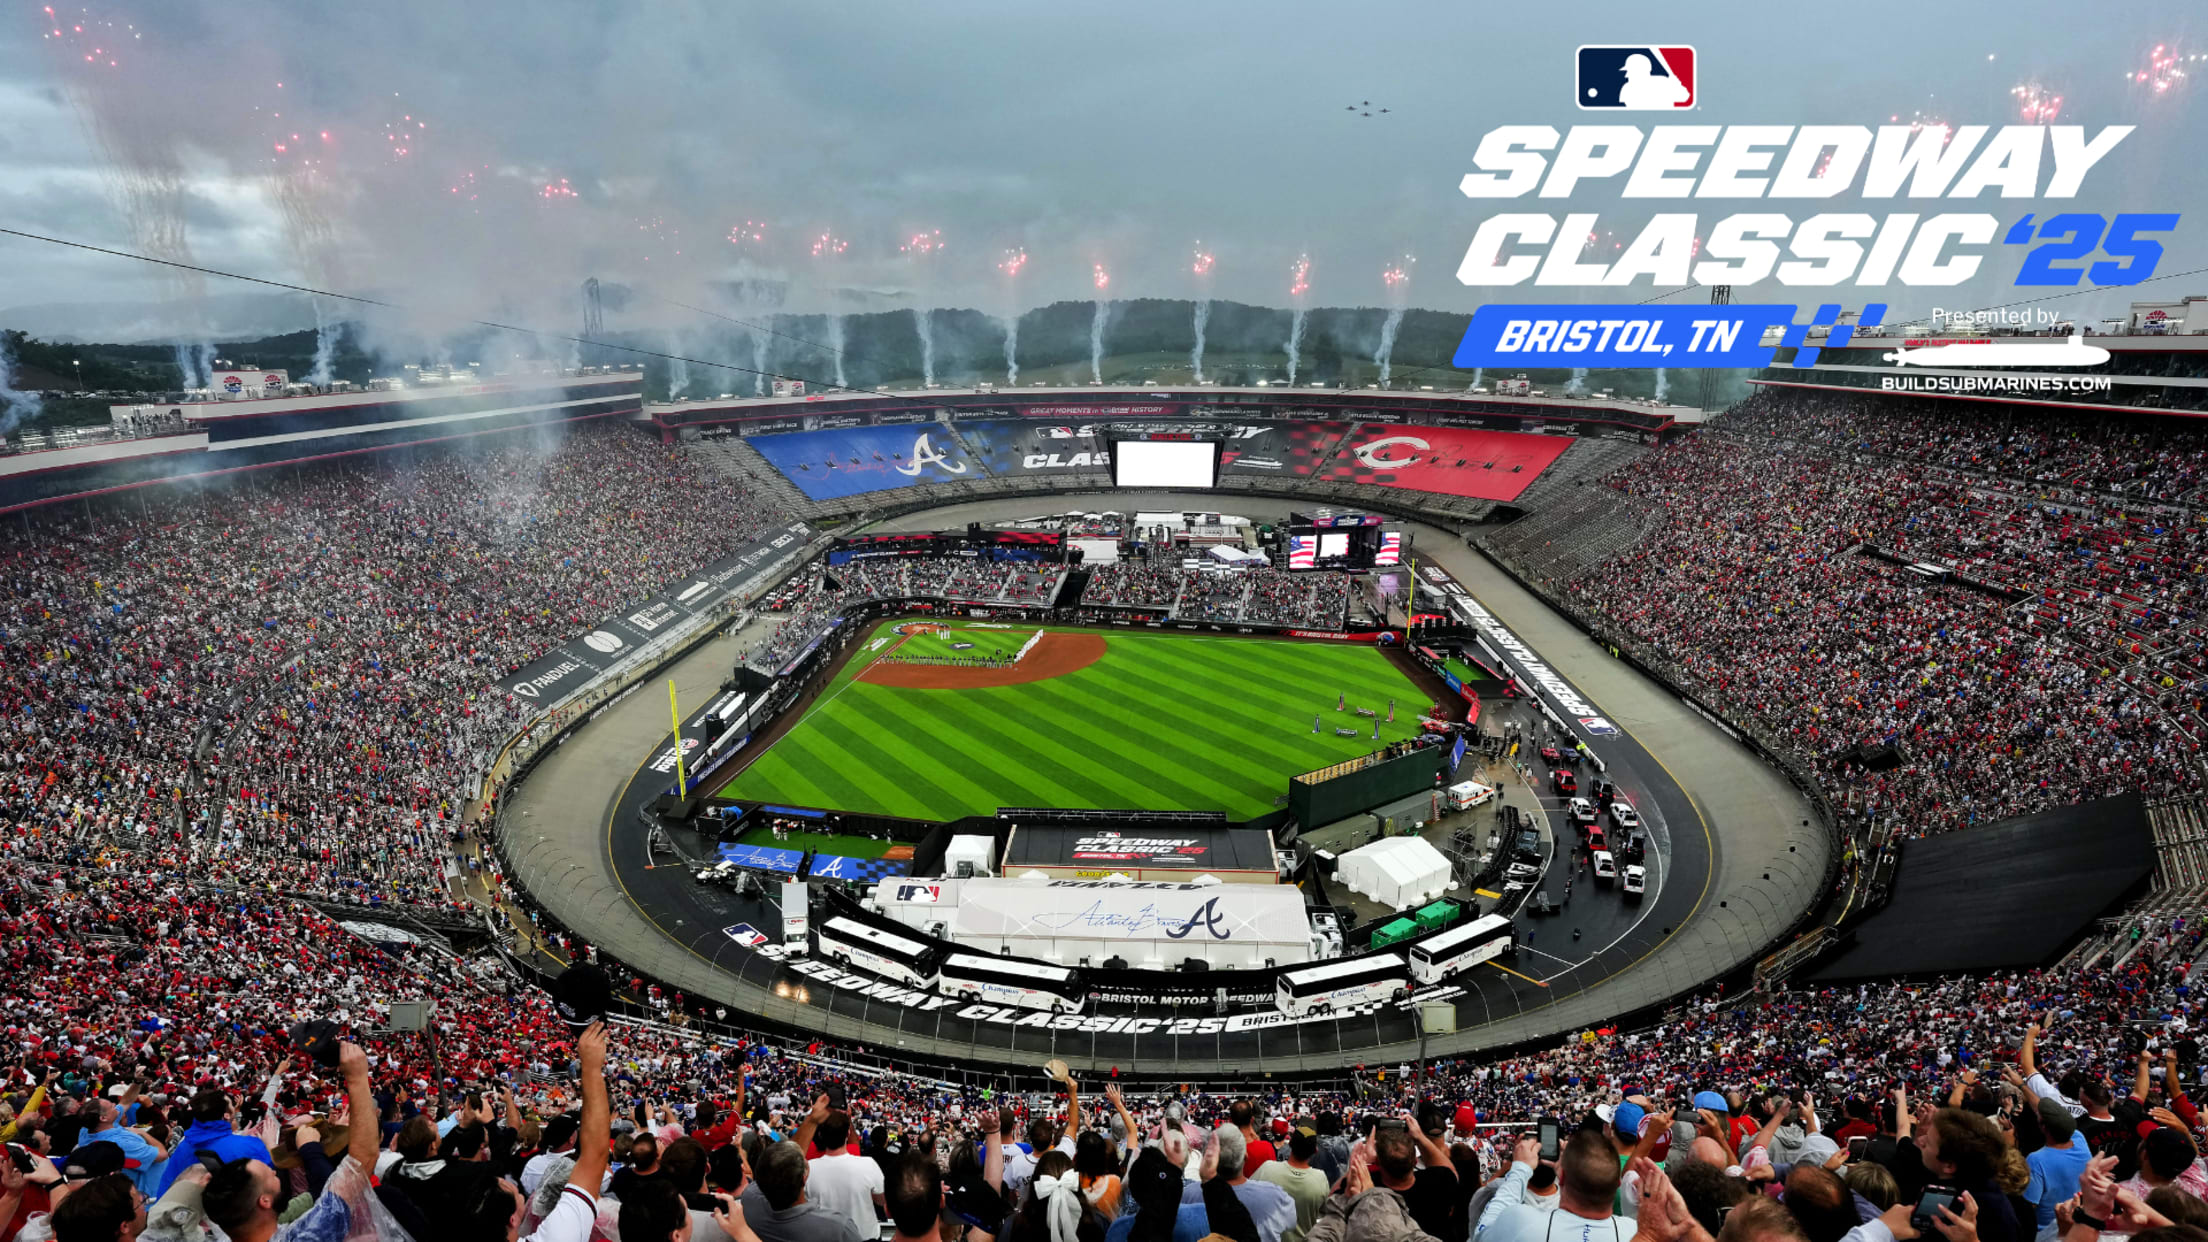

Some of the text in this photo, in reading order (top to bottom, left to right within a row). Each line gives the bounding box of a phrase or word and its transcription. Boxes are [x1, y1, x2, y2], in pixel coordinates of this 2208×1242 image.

[1030, 407, 1055, 415] GREAT
[1056, 407, 1091, 415] MOMENTS
[1132, 406, 1164, 414] HISTORY
[1151, 433, 1193, 441] BRISTOL
[531, 661, 581, 689] FANDUEL
[1076, 837, 1199, 847] SPEEDWAY
[1074, 845, 1175, 853] CLASSIC
[1166, 896, 1231, 940] A
[1101, 993, 1155, 1005] BRISTOL
[1161, 996, 1209, 1006] MOTOR
[956, 1004, 1163, 1035] CLASSIC
